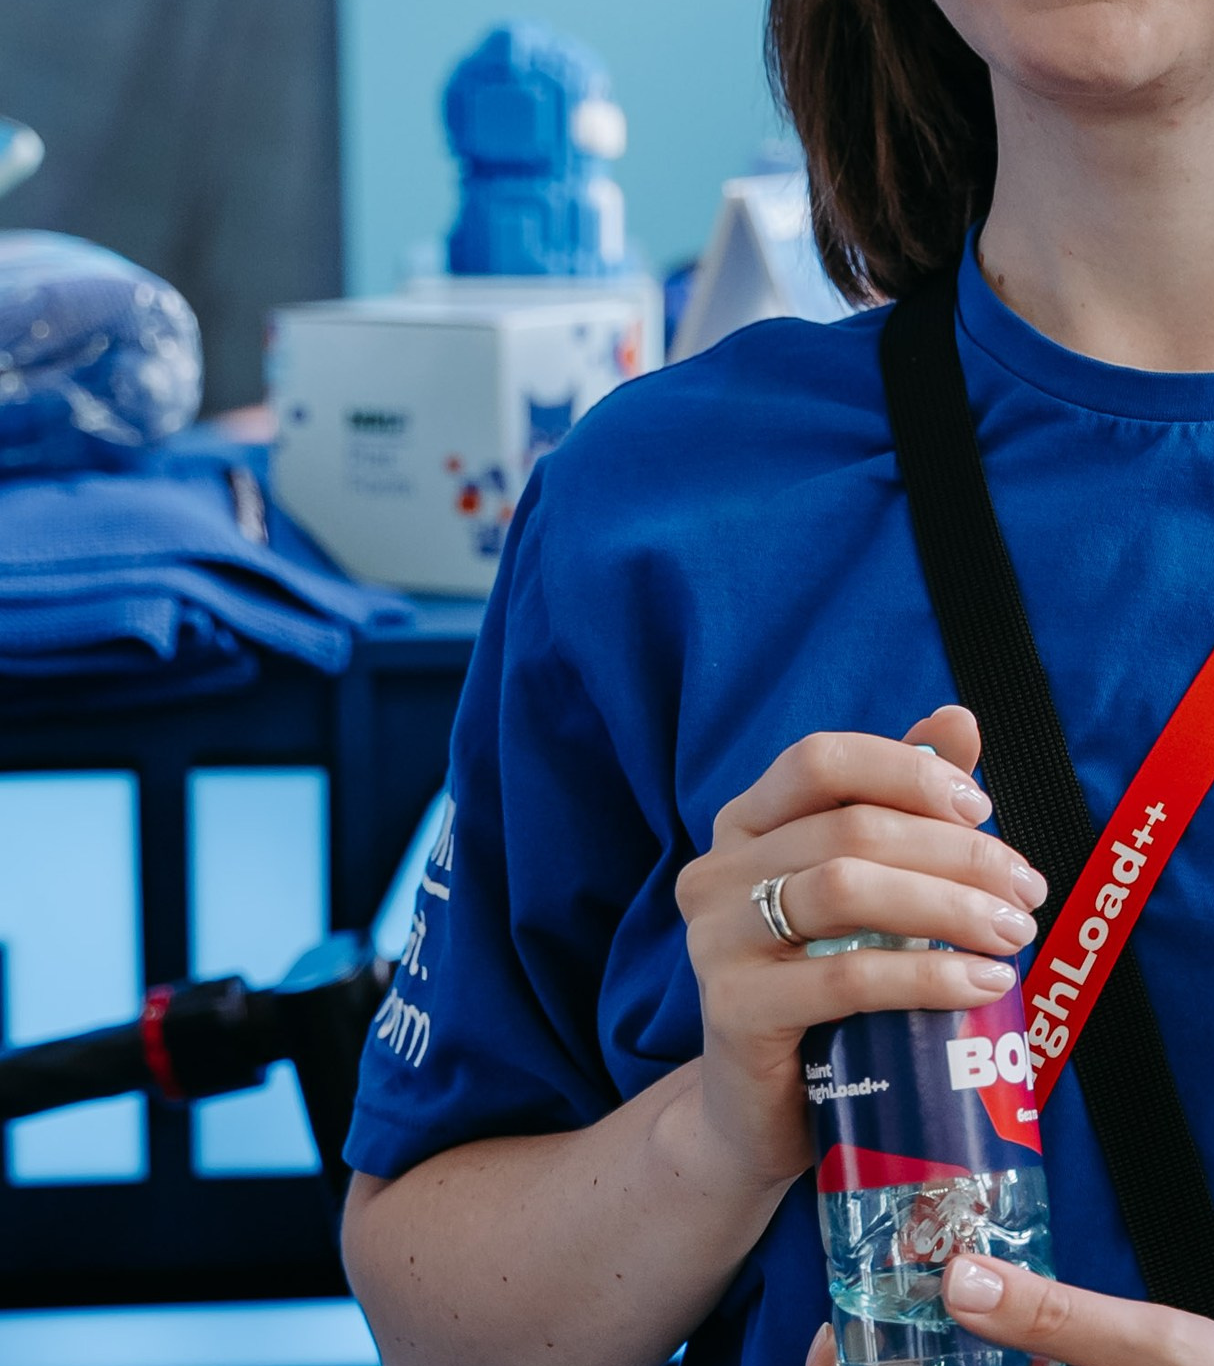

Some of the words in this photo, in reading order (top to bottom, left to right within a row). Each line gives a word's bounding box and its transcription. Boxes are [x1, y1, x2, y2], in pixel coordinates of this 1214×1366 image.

[1029, 801, 1169, 1083] ighLoad++
[805, 1063, 833, 1080] Saint
[945, 1031, 1034, 1092] ВО
[806, 1077, 890, 1105] HighLoad++
